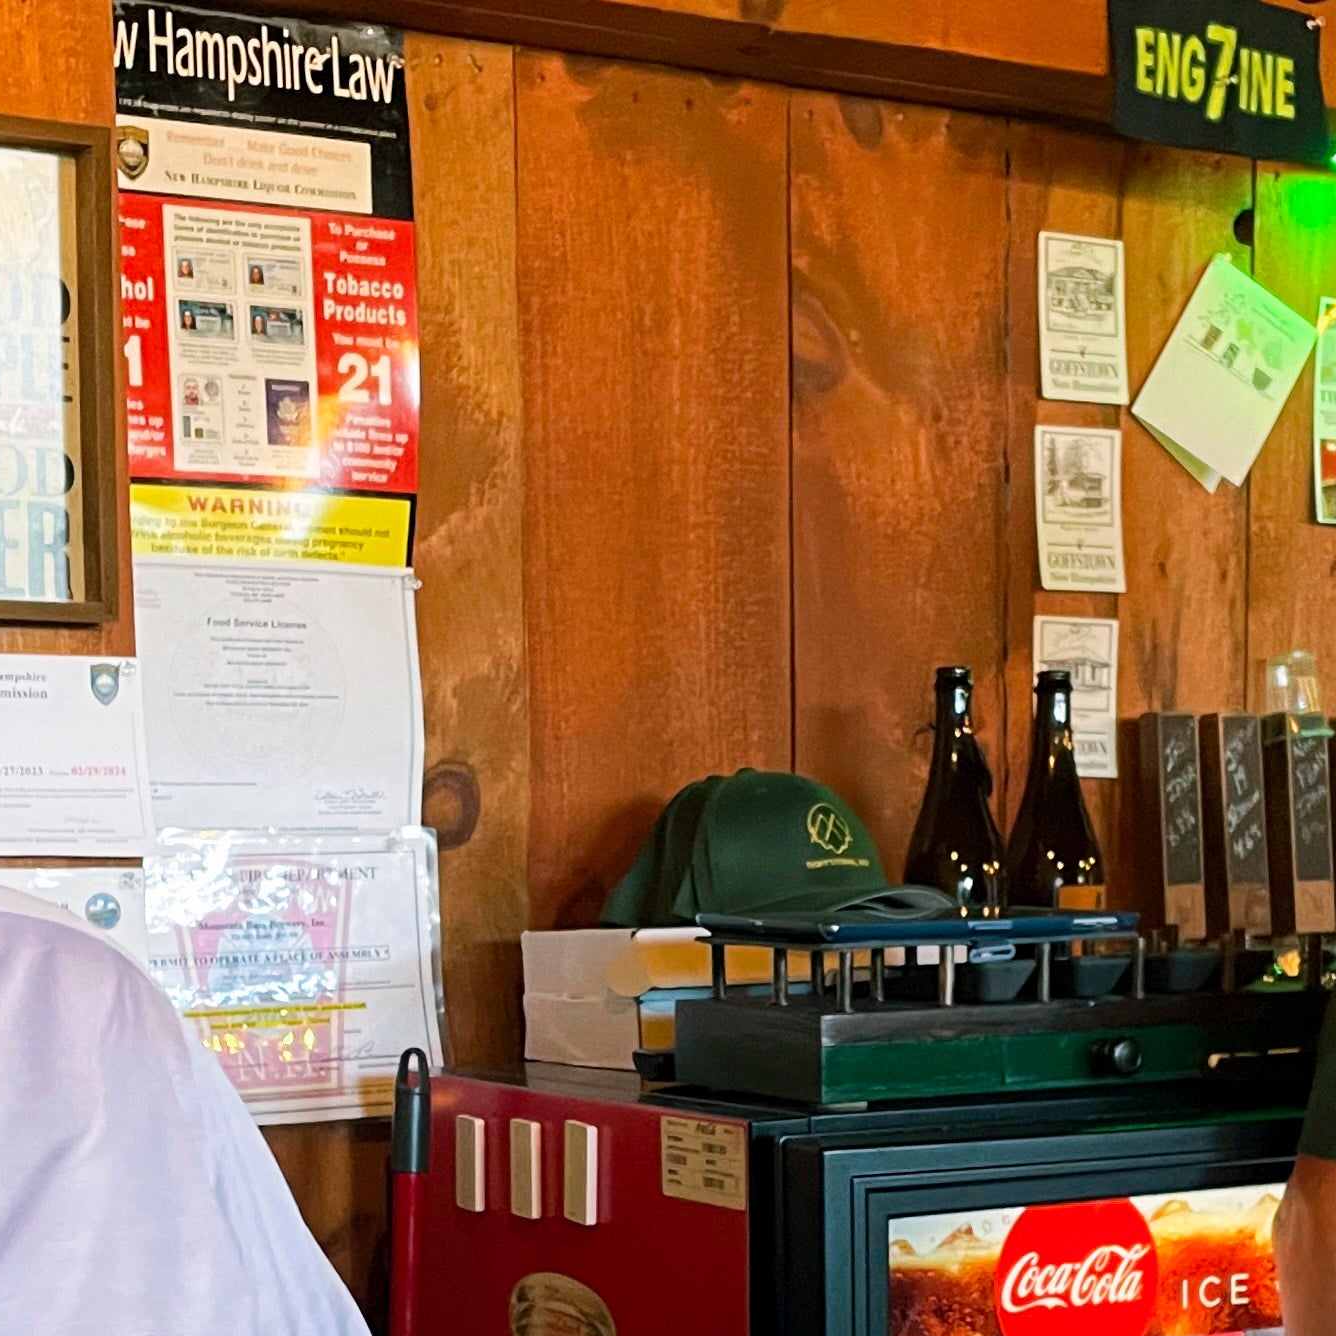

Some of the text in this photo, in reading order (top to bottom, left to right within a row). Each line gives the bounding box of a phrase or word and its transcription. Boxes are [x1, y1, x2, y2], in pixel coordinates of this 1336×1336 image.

[148, 9, 324, 102] Hampshire
[331, 34, 396, 104] Law
[268, 160, 289, 172] and
[328, 222, 343, 236] To
[323, 272, 404, 299] Tobacco
[323, 299, 407, 326] Products
[338, 353, 392, 406] 21
[206, 617, 231, 628] Food
[233, 618, 269, 629] Service
[1000, 1243, 1151, 1314] Coca-Cola
[1180, 1273, 1251, 1310] ICE
